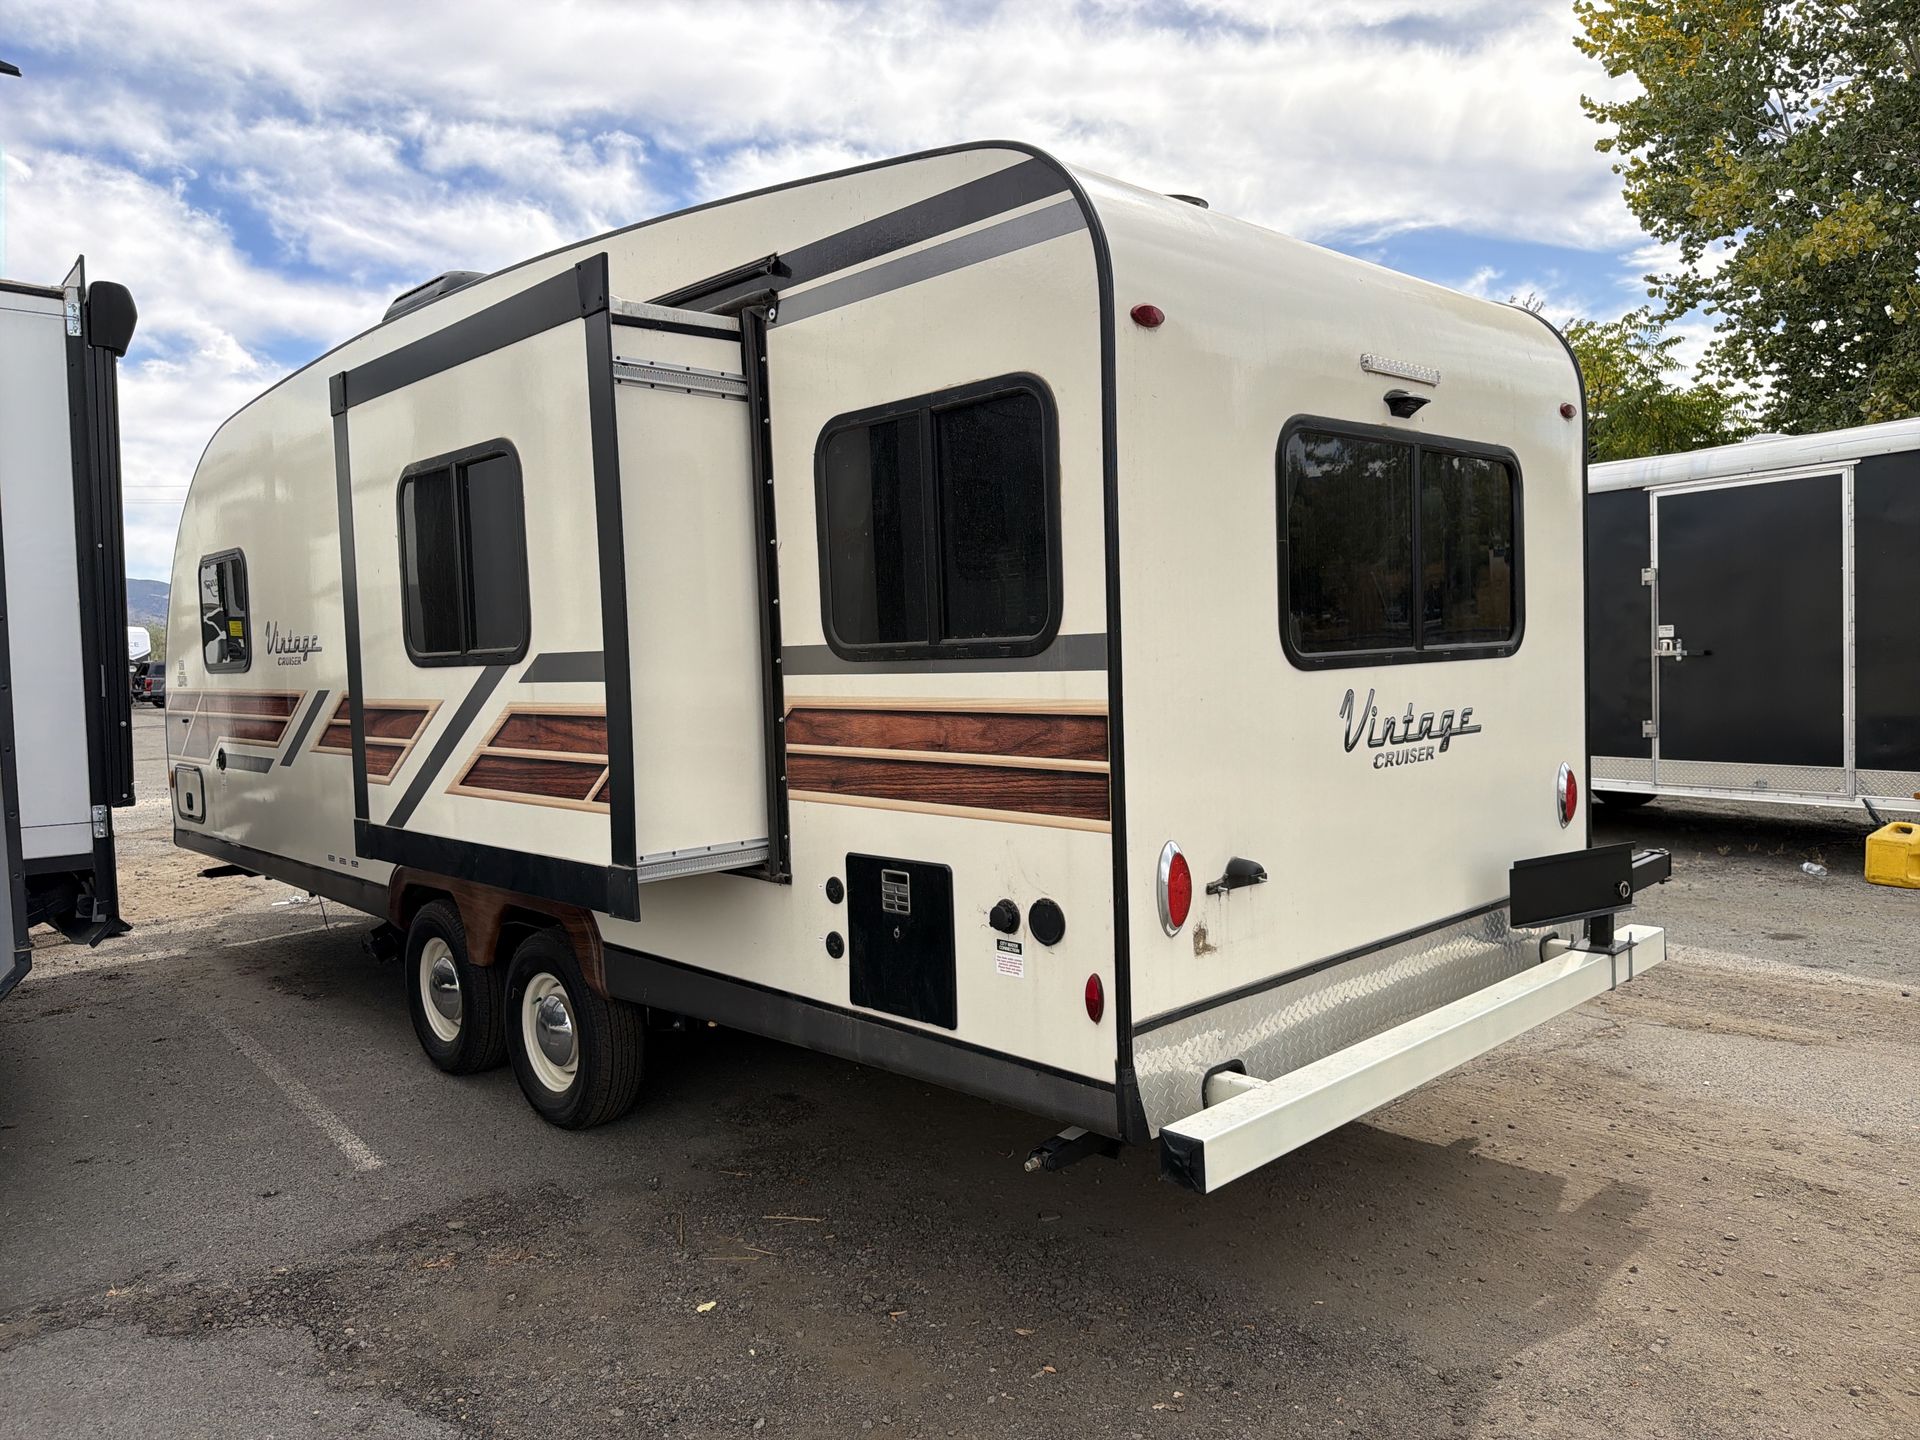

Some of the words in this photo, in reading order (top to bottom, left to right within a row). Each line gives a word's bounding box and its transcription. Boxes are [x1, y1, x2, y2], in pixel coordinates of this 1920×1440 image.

[266, 620, 322, 661] Vintage
[277, 656, 302, 666] CRUISER
[1339, 688, 1482, 753] Vintage
[1373, 745, 1435, 769] CRUISER
